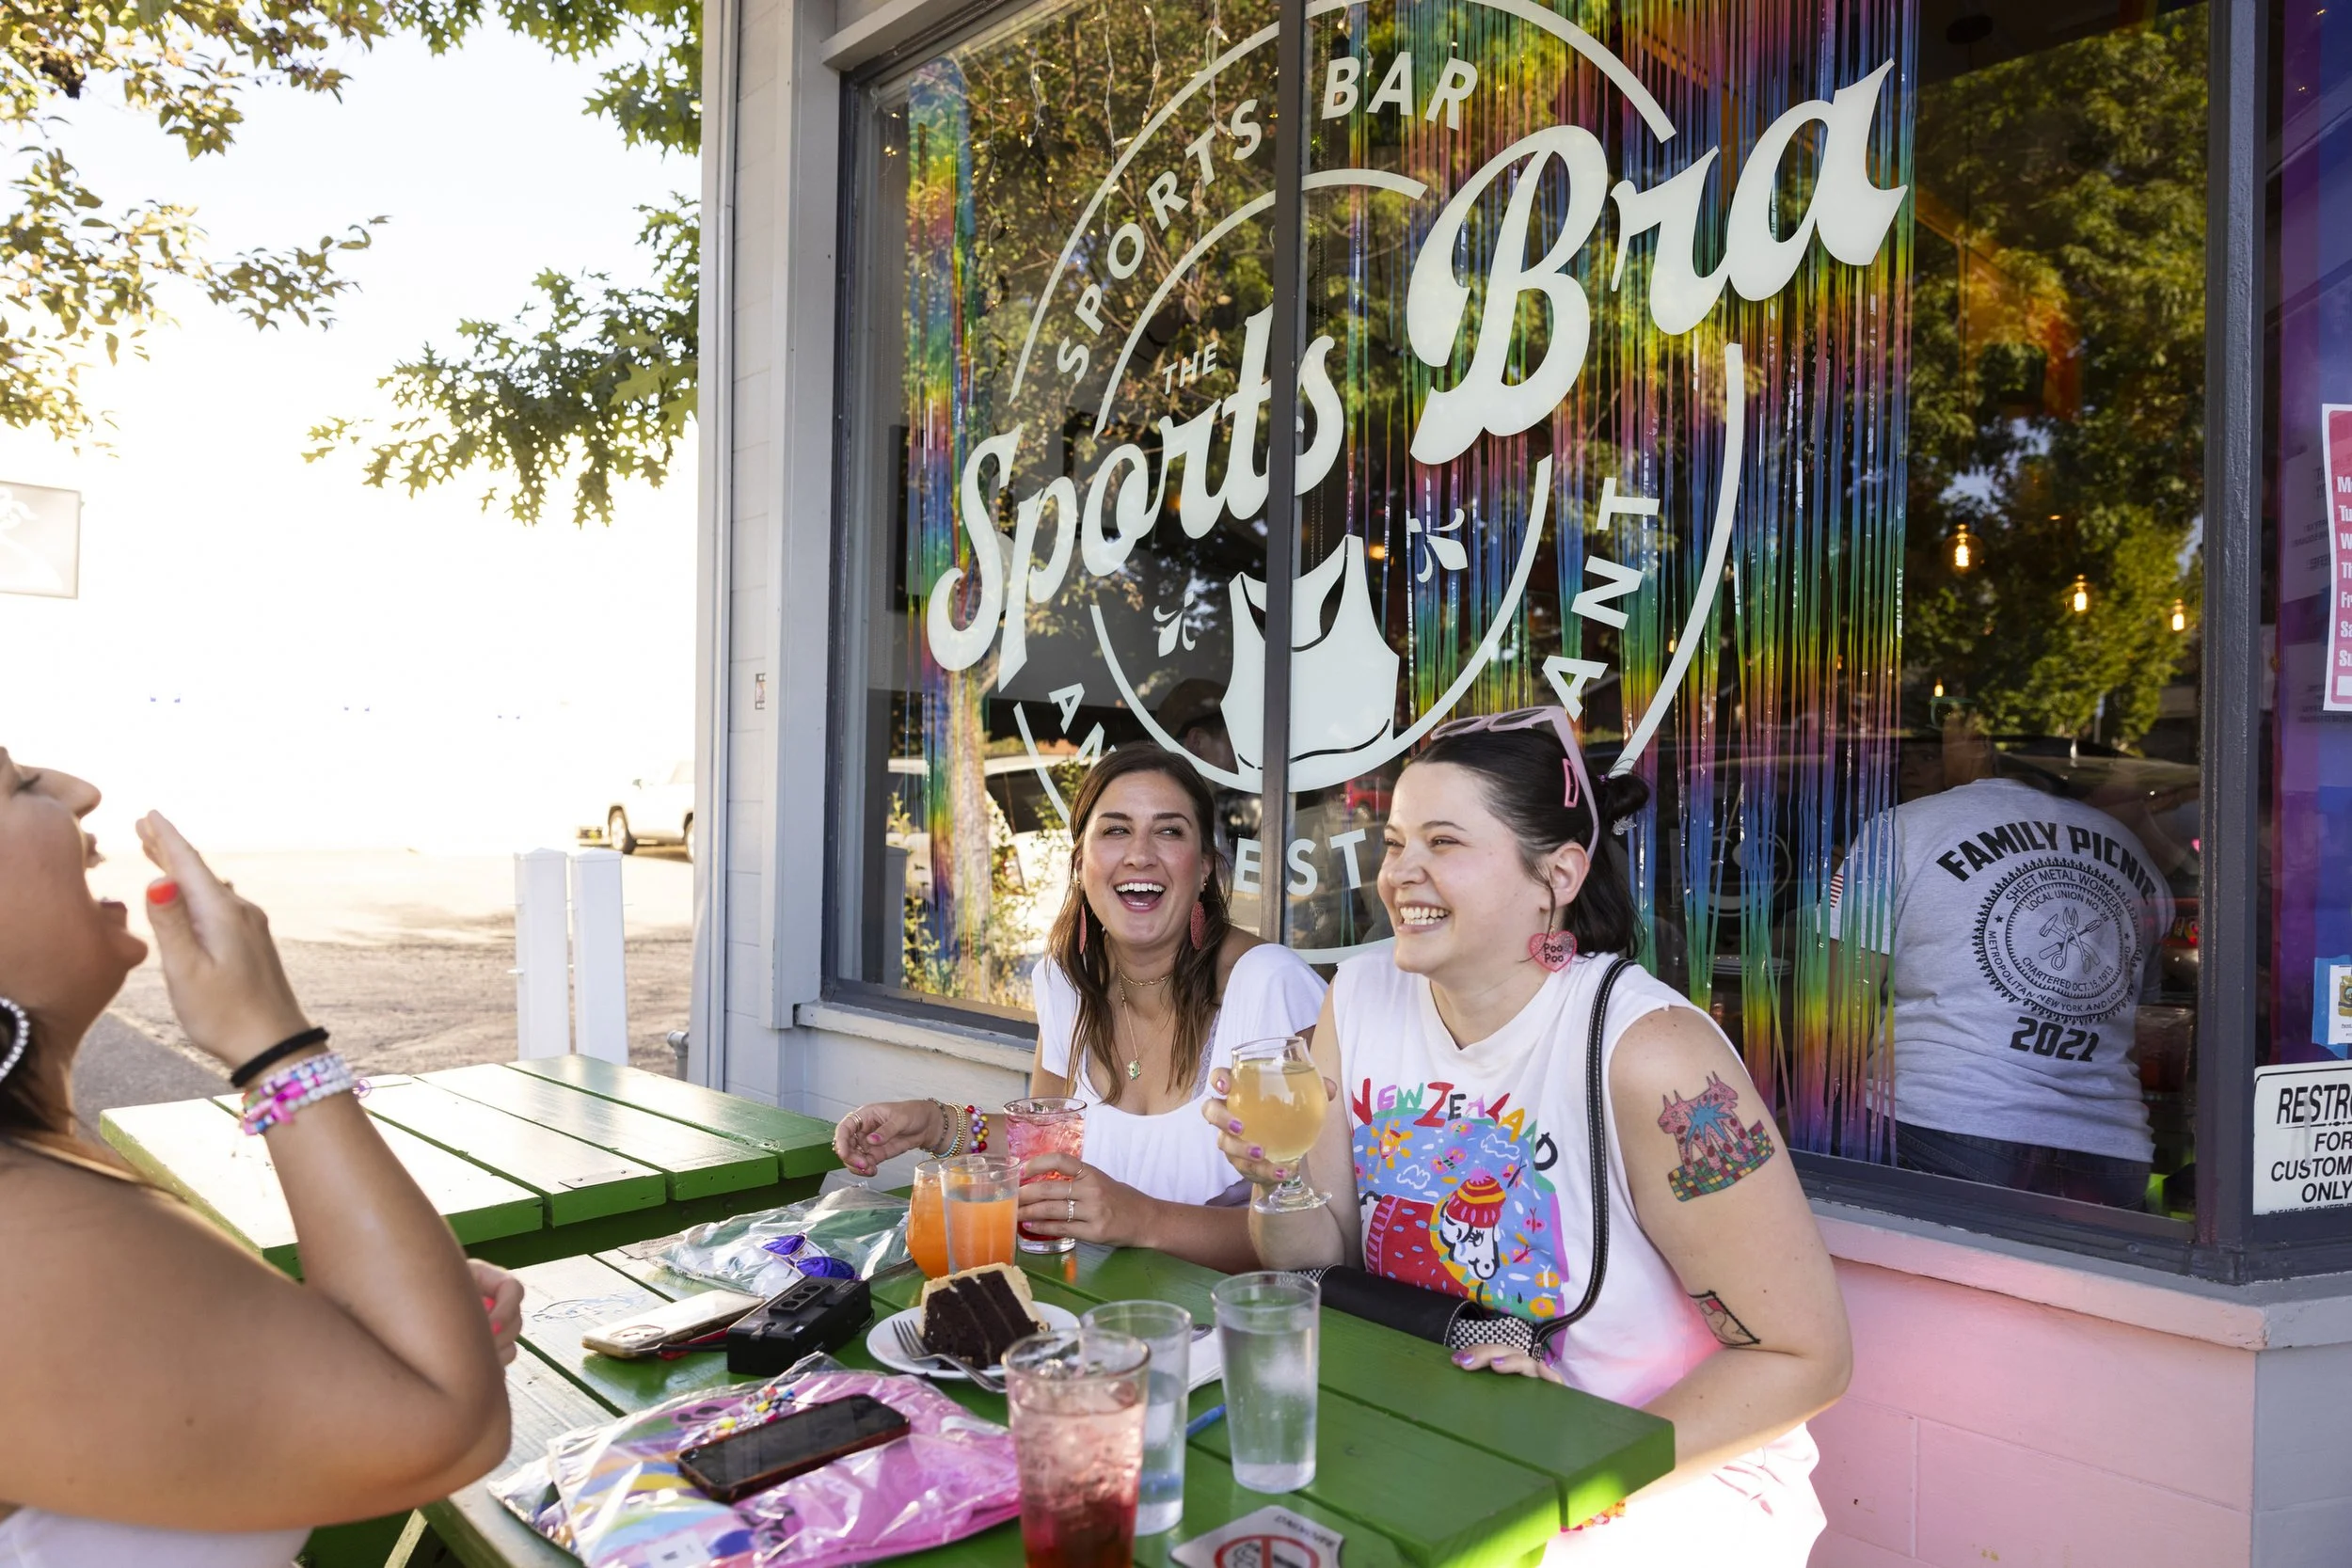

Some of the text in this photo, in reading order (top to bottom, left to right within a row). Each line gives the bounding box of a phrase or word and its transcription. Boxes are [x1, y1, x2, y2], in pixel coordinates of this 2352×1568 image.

[1056, 51, 1478, 383] SPORTS BAR
[927, 58, 1908, 692] Sports Bra
[1161, 340, 1219, 394] THE
[2337, 476, 2352, 493] M
[1936, 820, 2058, 882] FAMILY
[2006, 867, 2125, 918] SHEET METAL WORKERS
[2026, 888, 2110, 923] LOCAL UNION NO. 28
[1543, 942, 1563, 953] Poo
[1544, 953, 1564, 963] Poo
[1987, 930, 2127, 1012] METROPOLITAN NEW YORK AND LONG
[2022, 957, 2072, 989] CHARTERED
[2098, 965, 2115, 984] 1913
[2010, 1016, 2100, 1062] 2021
[2276, 1084, 2352, 1125] RESTR
[2314, 1131, 2352, 1152] FOR
[2301, 1180, 2352, 1203] ONLY
